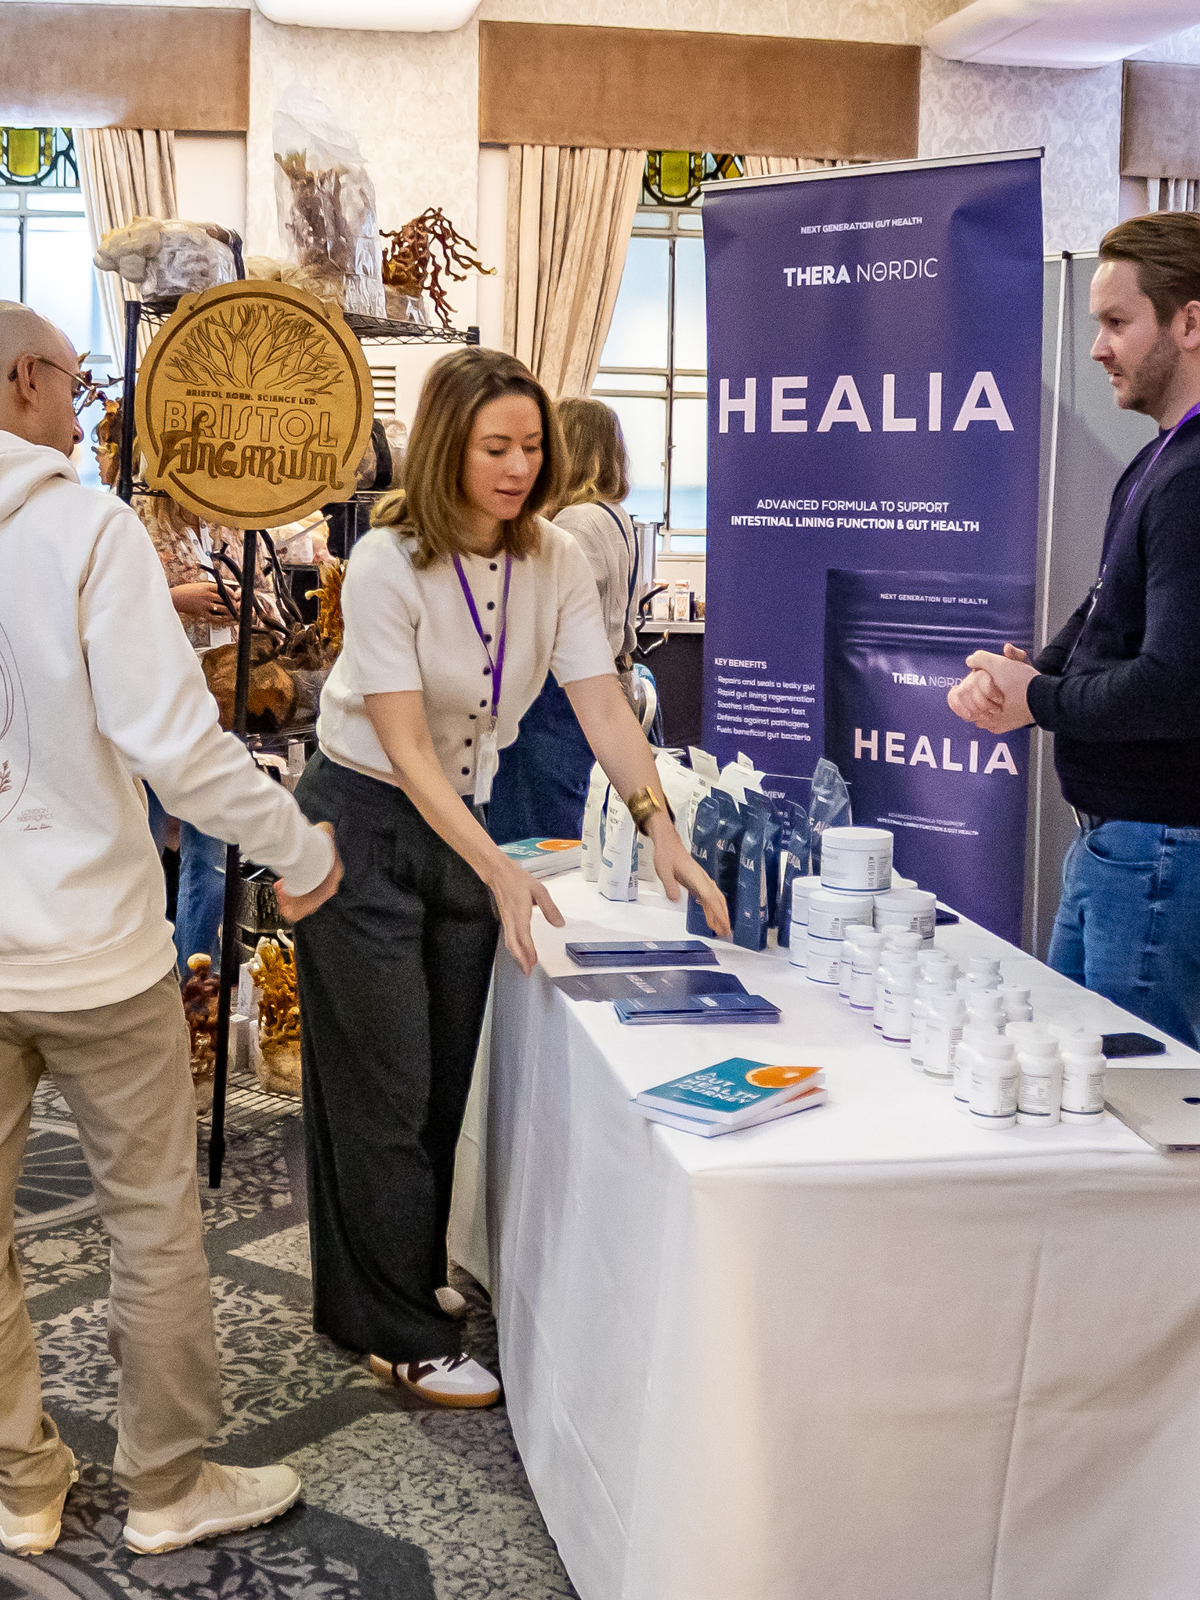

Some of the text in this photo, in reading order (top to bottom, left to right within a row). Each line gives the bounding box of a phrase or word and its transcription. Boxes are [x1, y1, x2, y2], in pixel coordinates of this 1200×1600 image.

[800, 217, 922, 234] NEXT GENERATION GUT HEALTH
[783, 264, 851, 287] THERA
[186, 389, 222, 398] BRISTOL
[226, 392, 254, 400] BORN.
[258, 394, 296, 403] SCIENCE
[719, 371, 1014, 433] HEALIA
[164, 400, 338, 447] BRISTOL
[757, 499, 949, 512] ADVANCED FORMULA TO SUPPORT
[731, 516, 980, 532] INTESTINAL LINING FUNCTION & GUT HEALTH
[898, 594, 940, 603] GENERATION
[728, 660, 767, 669] BENEFITS
[718, 676, 741, 685] Repairs
[783, 681, 802, 691] leaky
[802, 684, 815, 692] gut
[891, 672, 963, 688] THERA NORD
[718, 688, 815, 703] Rapid gut lining regeneration
[718, 700, 742, 710] Soothes
[743, 704, 790, 714] inflammation
[717, 713, 809, 729] Defends against pathogens
[717, 725, 811, 741] Fuels beneficial gut bacteria
[854, 728, 1018, 776] HEALIA
[682, 1079, 762, 1099] HEALTH
